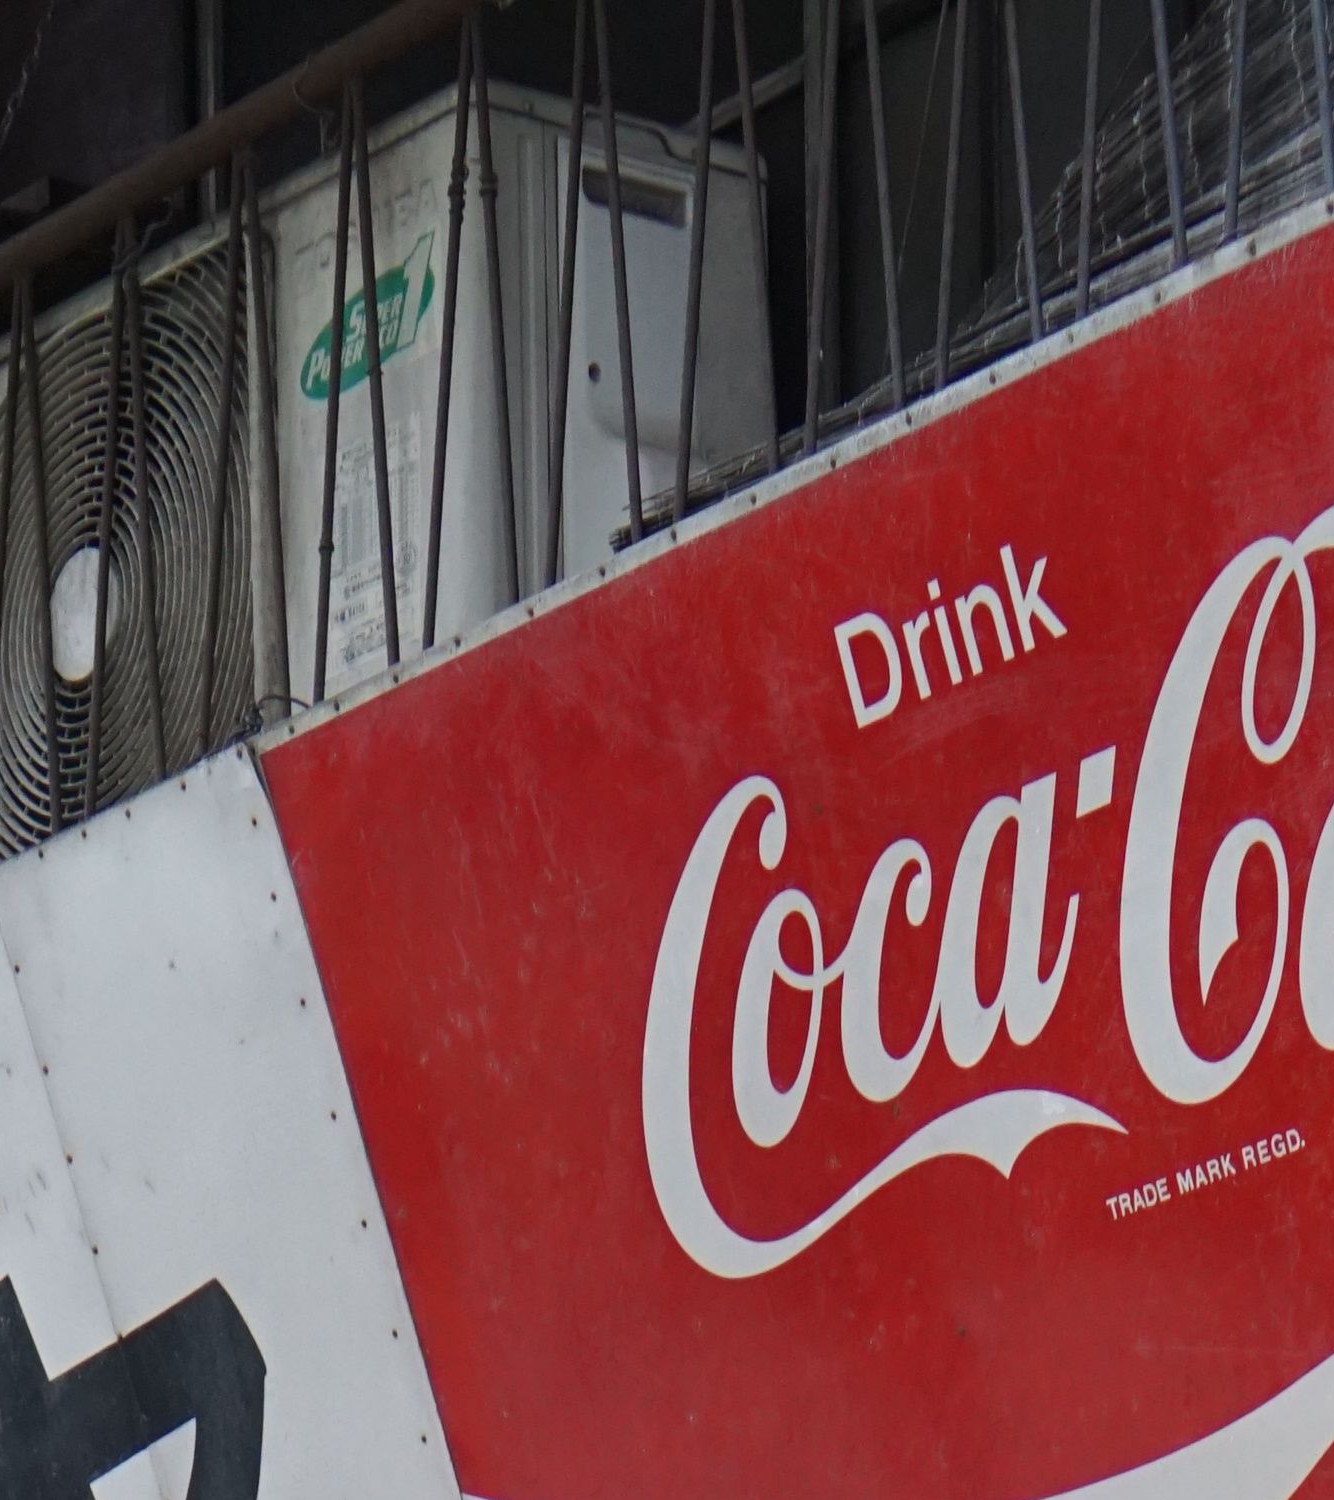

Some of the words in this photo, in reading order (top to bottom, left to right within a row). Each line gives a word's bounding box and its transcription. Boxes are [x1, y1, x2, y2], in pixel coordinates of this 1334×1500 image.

[834, 544, 1068, 728] Drink
[1105, 1177, 1171, 1220] TRADE
[1176, 1152, 1236, 1194] MARK
[1241, 1128, 1305, 1170] REGD.
